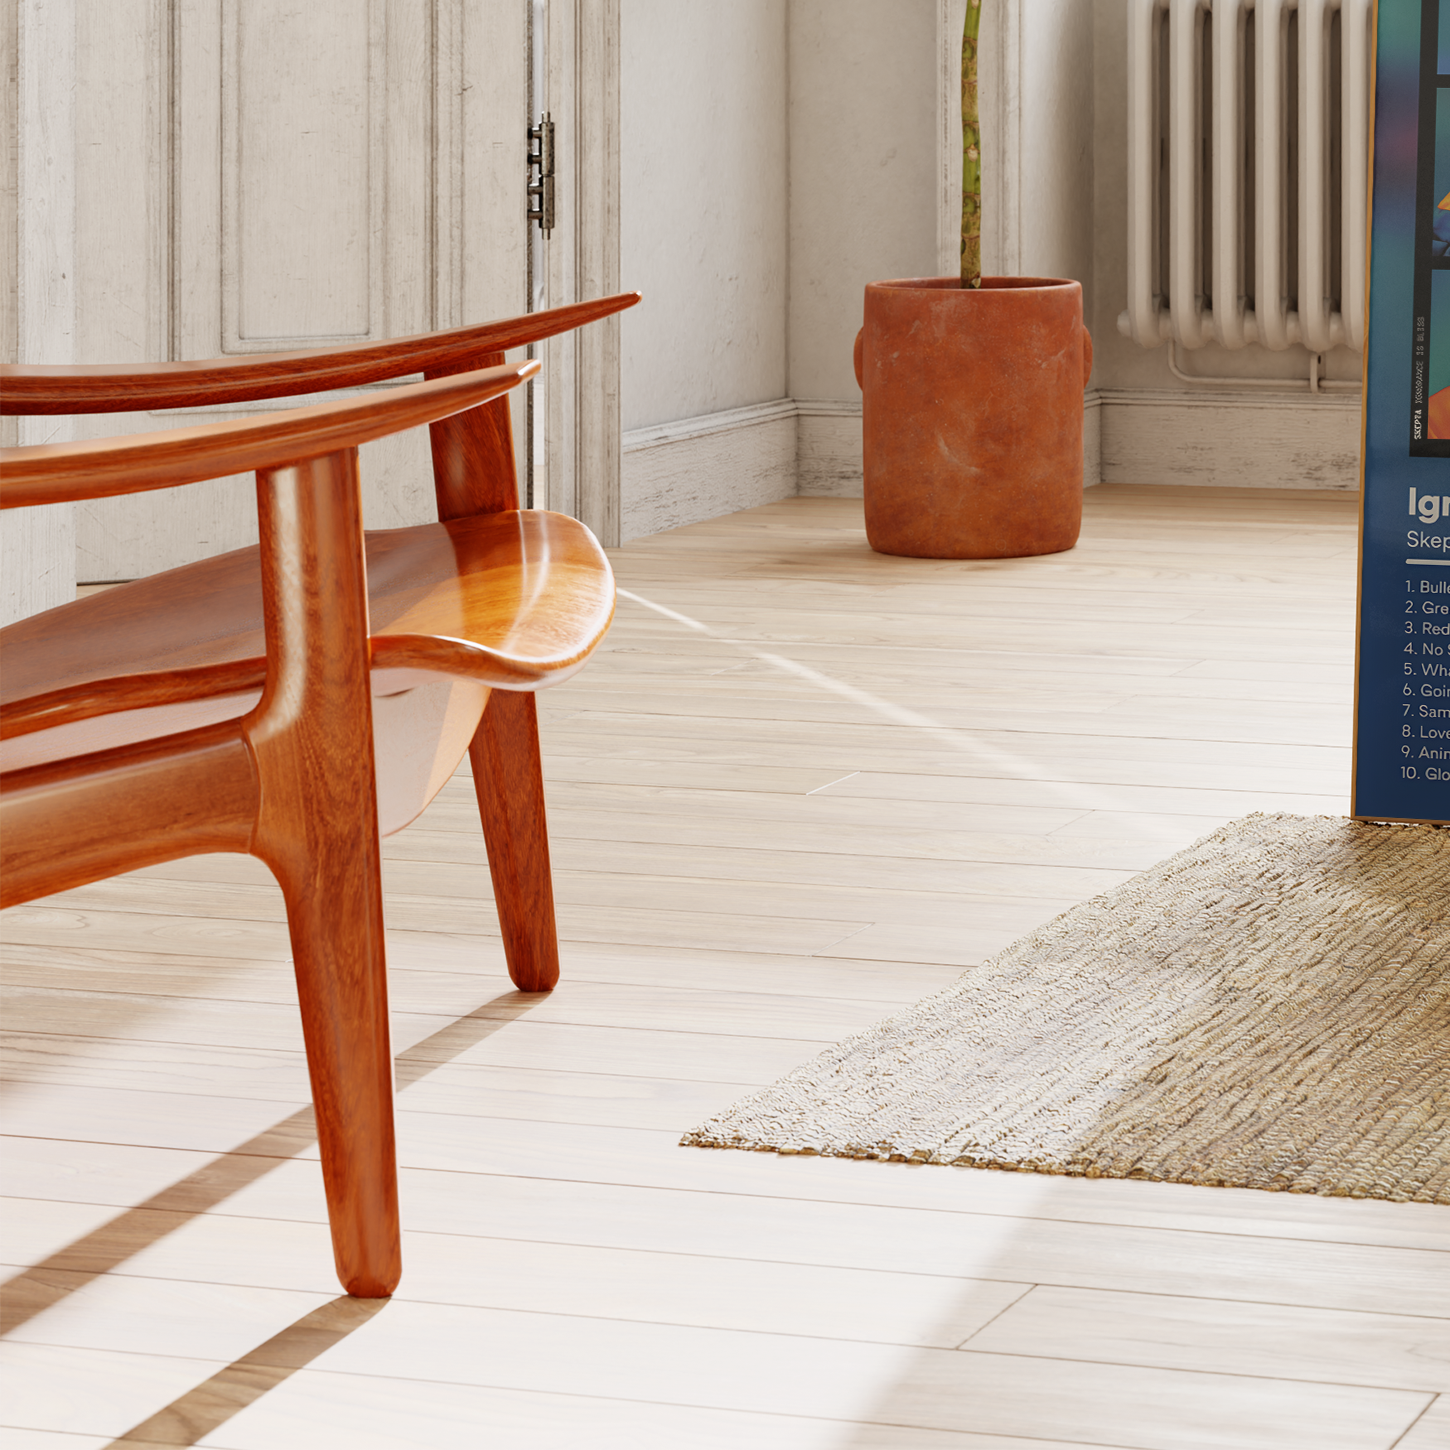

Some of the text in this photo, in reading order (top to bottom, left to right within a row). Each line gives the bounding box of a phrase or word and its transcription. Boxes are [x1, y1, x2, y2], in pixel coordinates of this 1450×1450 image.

[1414, 409, 1423, 440] SKEPTA
[1405, 579, 1415, 593] 1.
[1404, 599, 1418, 614] 2.
[1404, 620, 1418, 634] 3.
[1403, 641, 1418, 655] 4.
[1422, 642, 1444, 656] No
[1403, 662, 1417, 676] 5.
[1402, 682, 1416, 696] 6.
[1402, 703, 1415, 717] 7.
[1401, 724, 1416, 738] 8.
[1400, 744, 1414, 759] 9.
[1400, 765, 1421, 780] 10.
